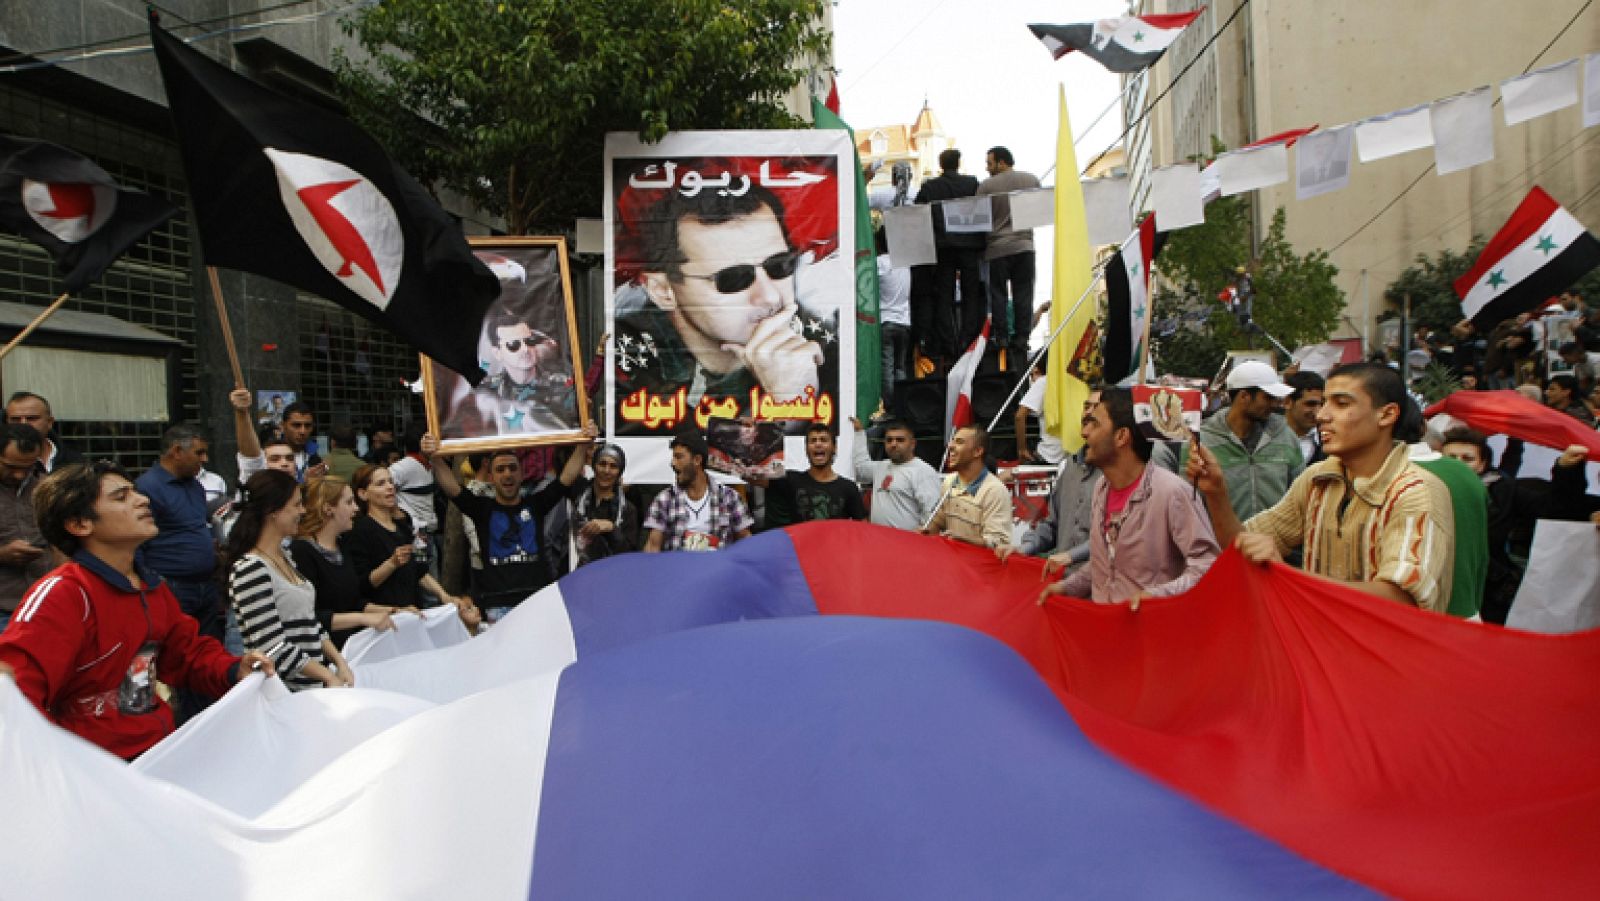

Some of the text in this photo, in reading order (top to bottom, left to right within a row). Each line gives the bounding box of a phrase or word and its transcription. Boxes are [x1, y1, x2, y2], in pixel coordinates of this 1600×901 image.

[629, 160, 828, 197] حاربوك
[620, 384, 832, 429] ونسوا من ابوك
